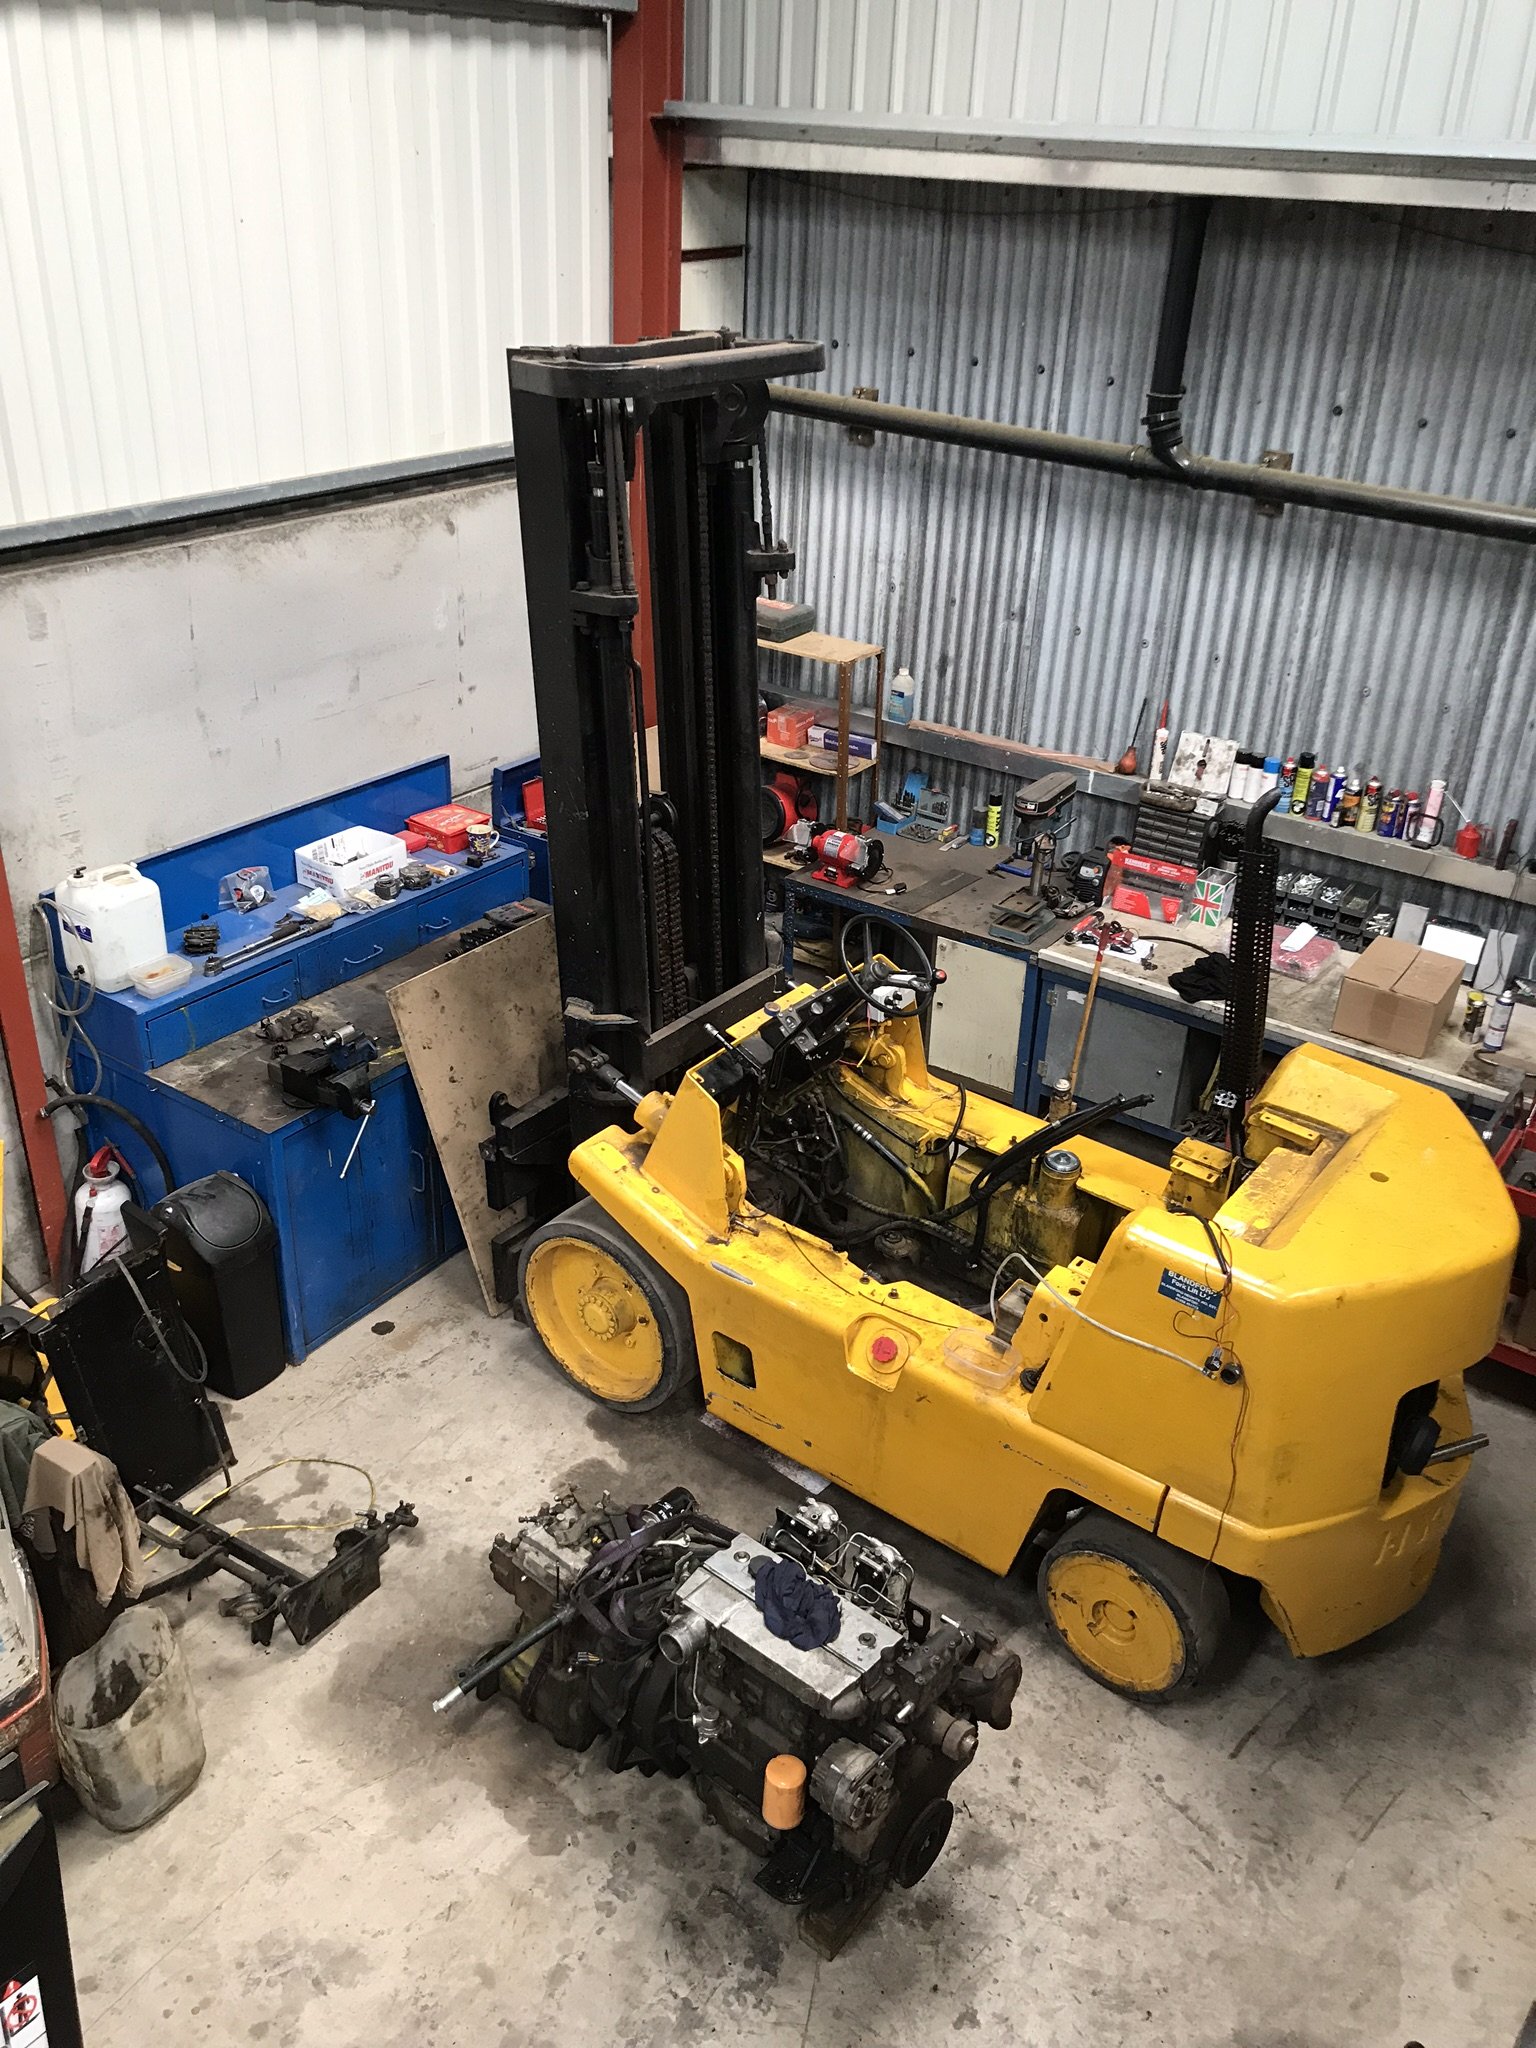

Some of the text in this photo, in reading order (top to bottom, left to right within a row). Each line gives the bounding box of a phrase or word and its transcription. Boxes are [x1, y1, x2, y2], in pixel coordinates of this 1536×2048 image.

[365, 860, 394, 878] MANITOU
[1171, 1278, 1186, 1290] Fork
[1187, 1285, 1198, 1295] Lift
